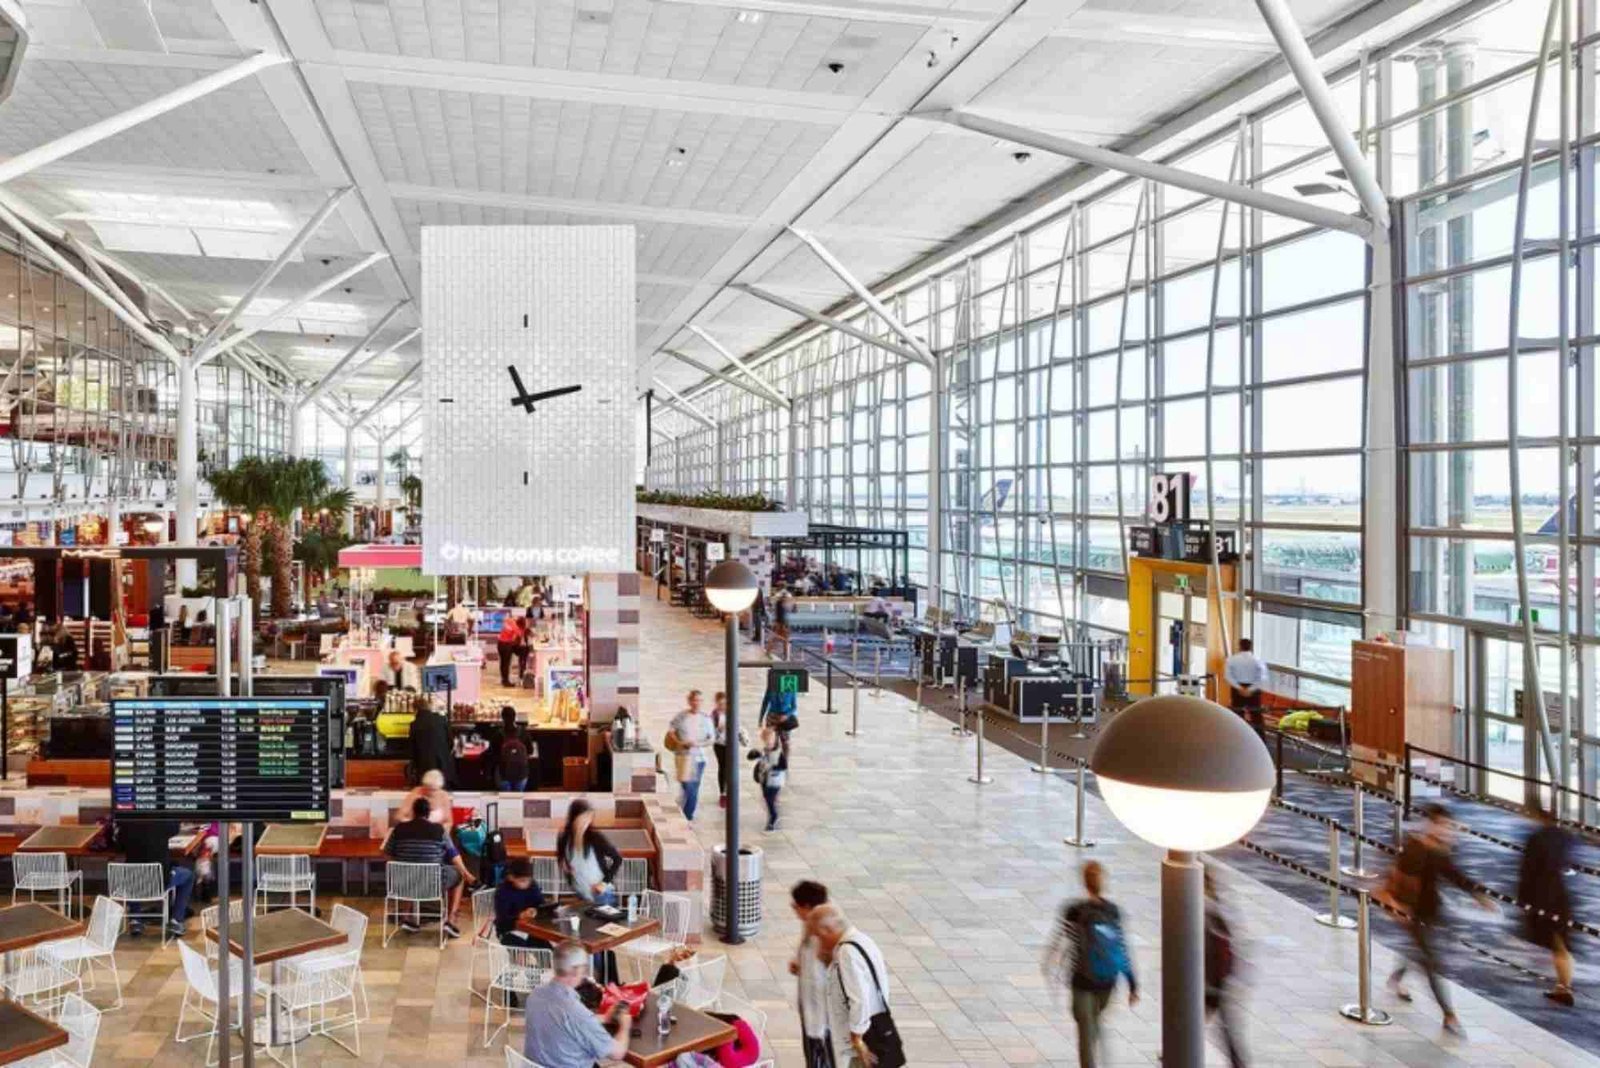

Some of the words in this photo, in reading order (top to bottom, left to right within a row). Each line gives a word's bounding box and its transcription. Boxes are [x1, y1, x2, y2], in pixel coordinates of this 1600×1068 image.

[1151, 474, 1183, 523] 81
[61, 549, 121, 558] MAC
[462, 544, 553, 563] hudsons
[556, 545, 620, 563] coffee
